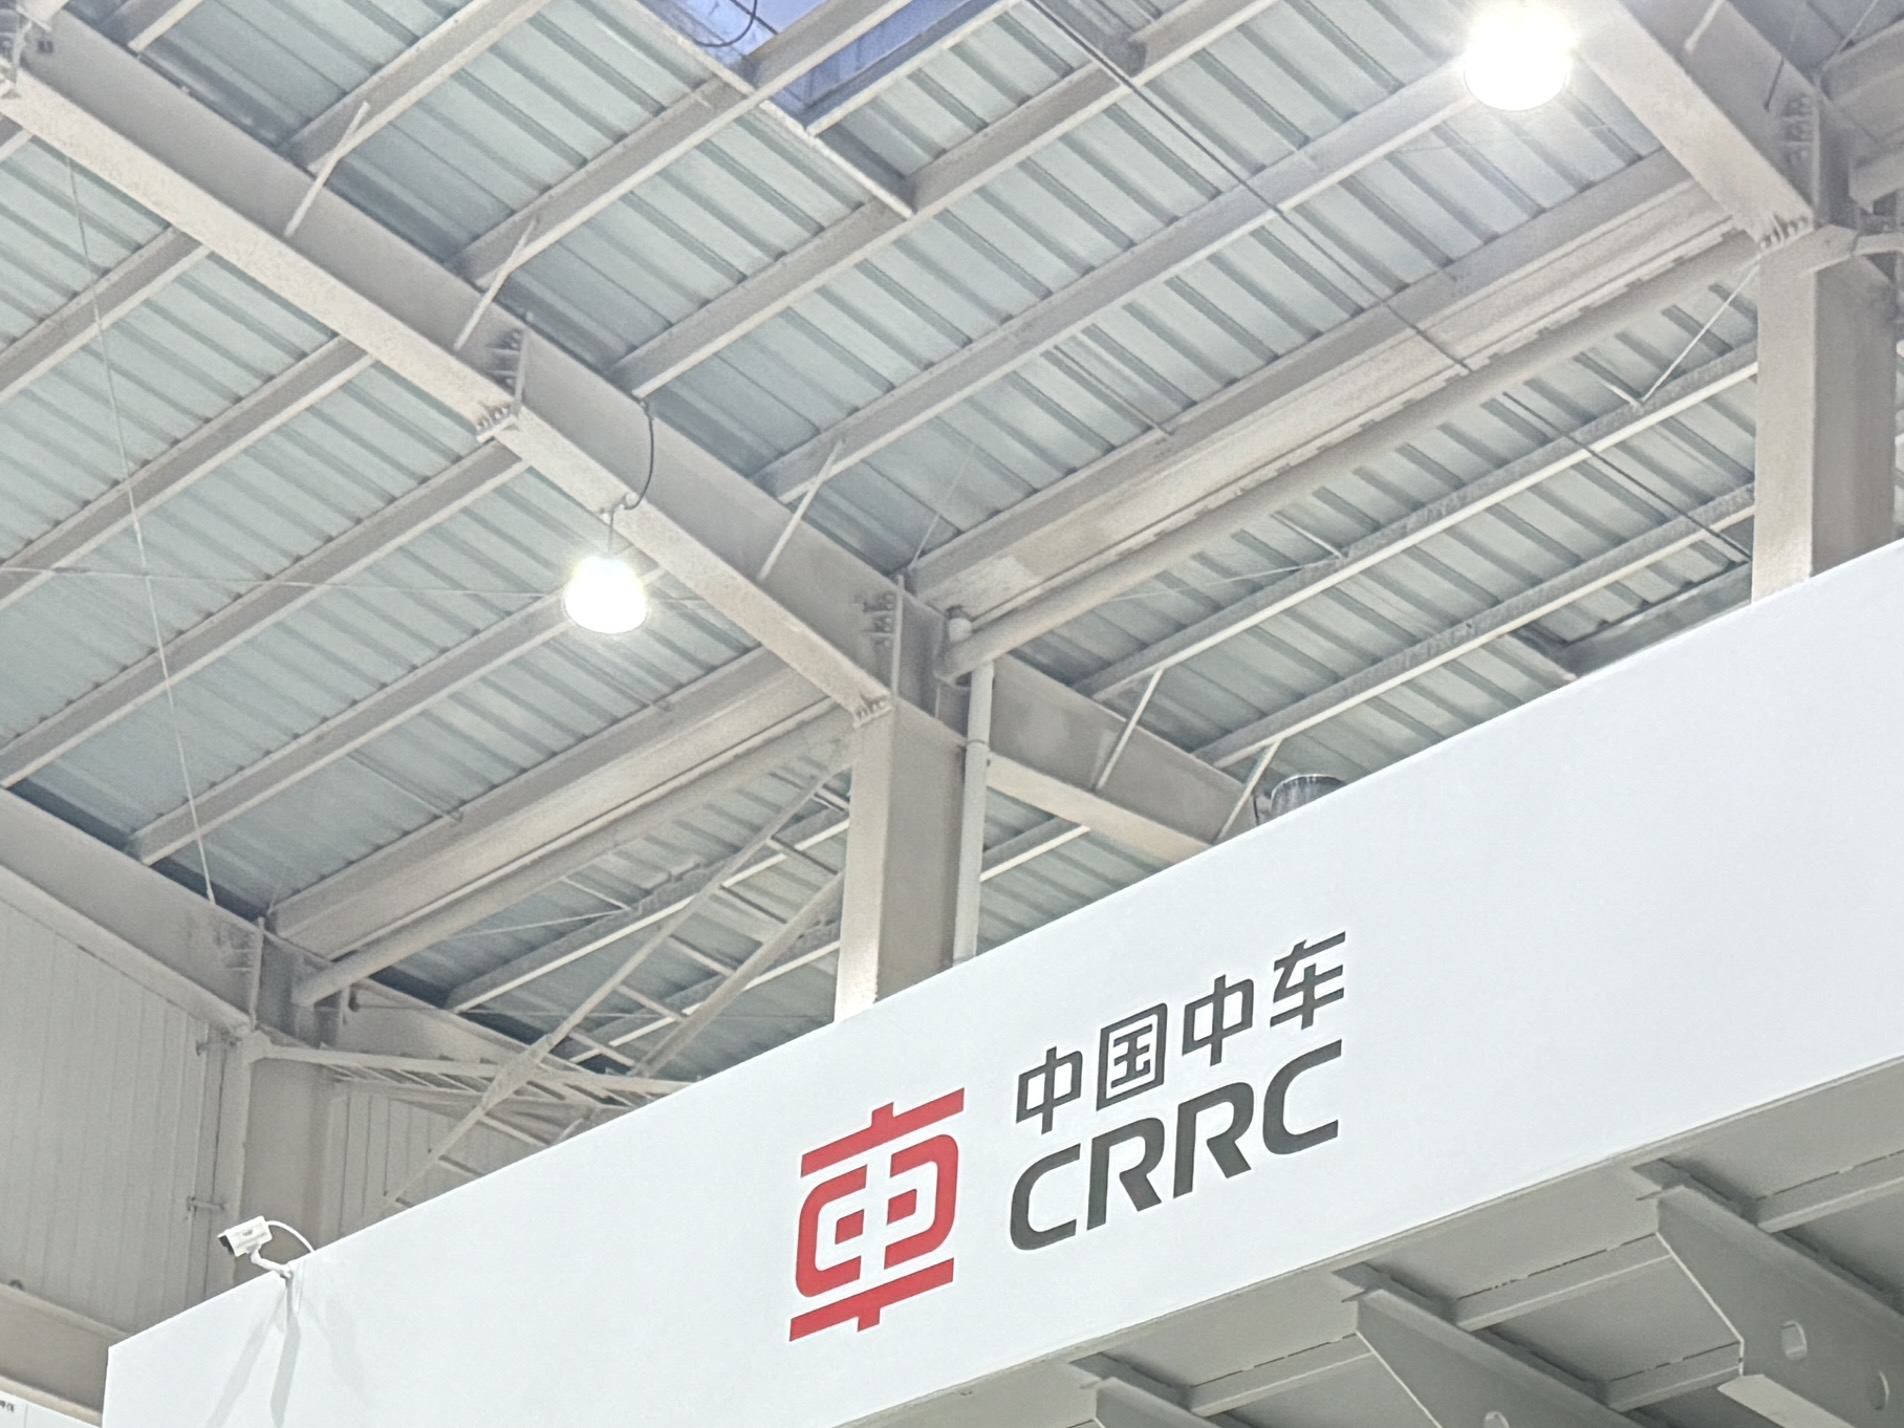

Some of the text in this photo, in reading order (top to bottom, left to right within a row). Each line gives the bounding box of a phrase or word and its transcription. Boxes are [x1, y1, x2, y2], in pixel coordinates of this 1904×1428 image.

[1015, 930, 1346, 1135] 中国中车
[1009, 1038, 1343, 1251] CRRC
